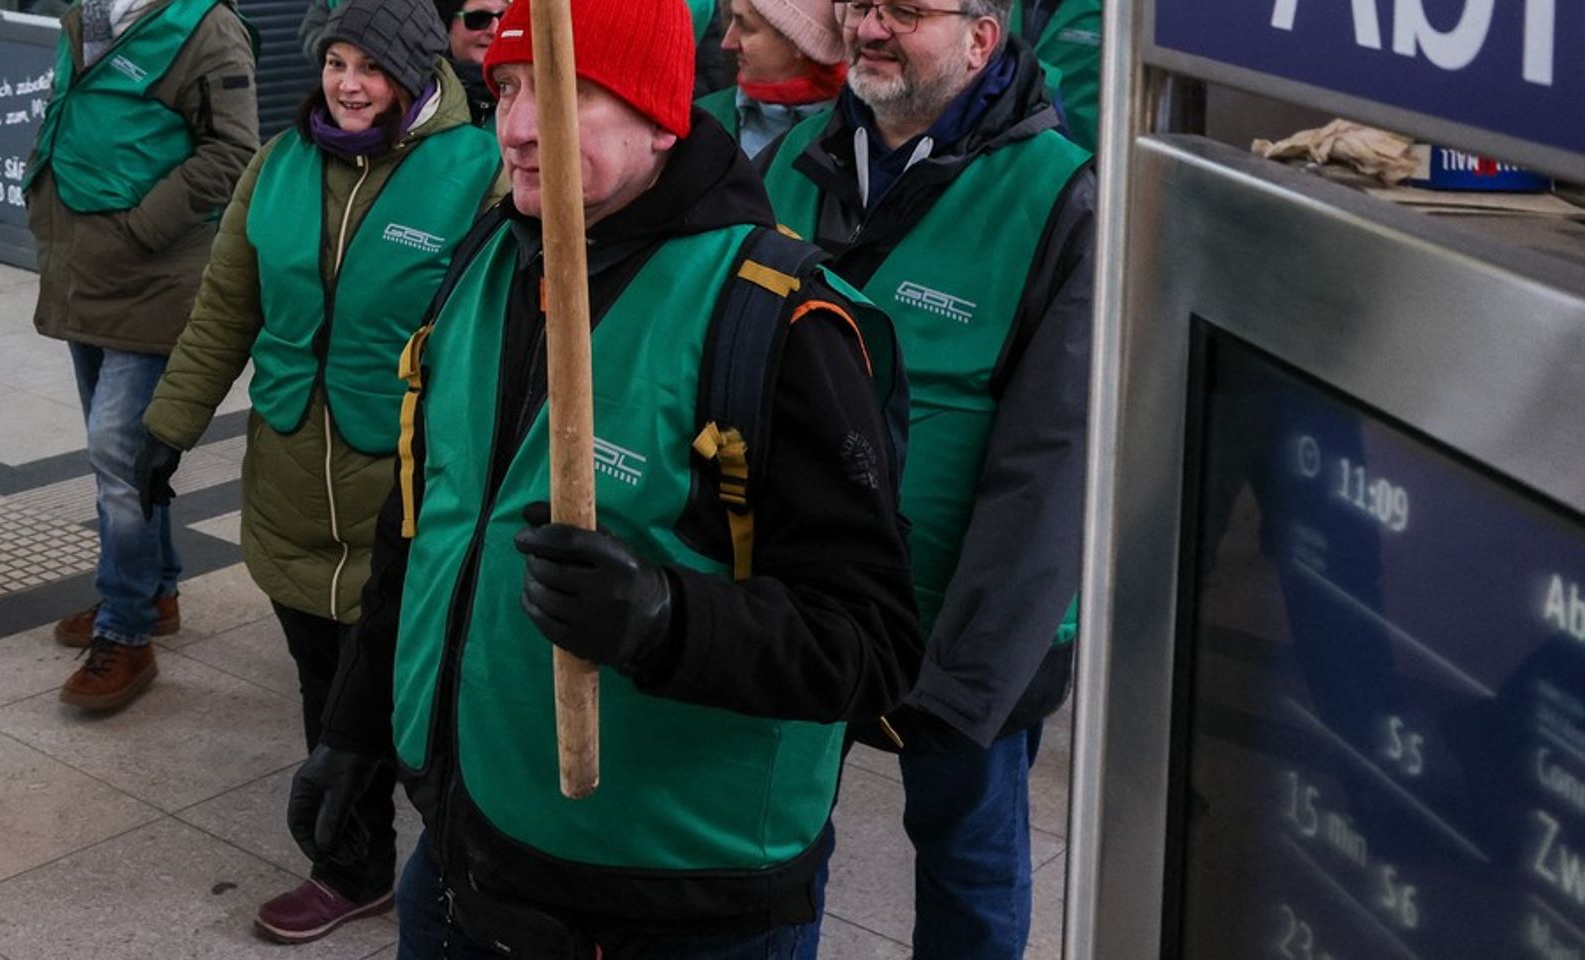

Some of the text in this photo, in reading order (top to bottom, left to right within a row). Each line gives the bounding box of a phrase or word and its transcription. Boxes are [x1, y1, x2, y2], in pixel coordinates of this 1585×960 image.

[384, 223, 445, 249] GDL
[896, 281, 976, 318] GDL
[1339, 457, 1409, 532] 11:09
